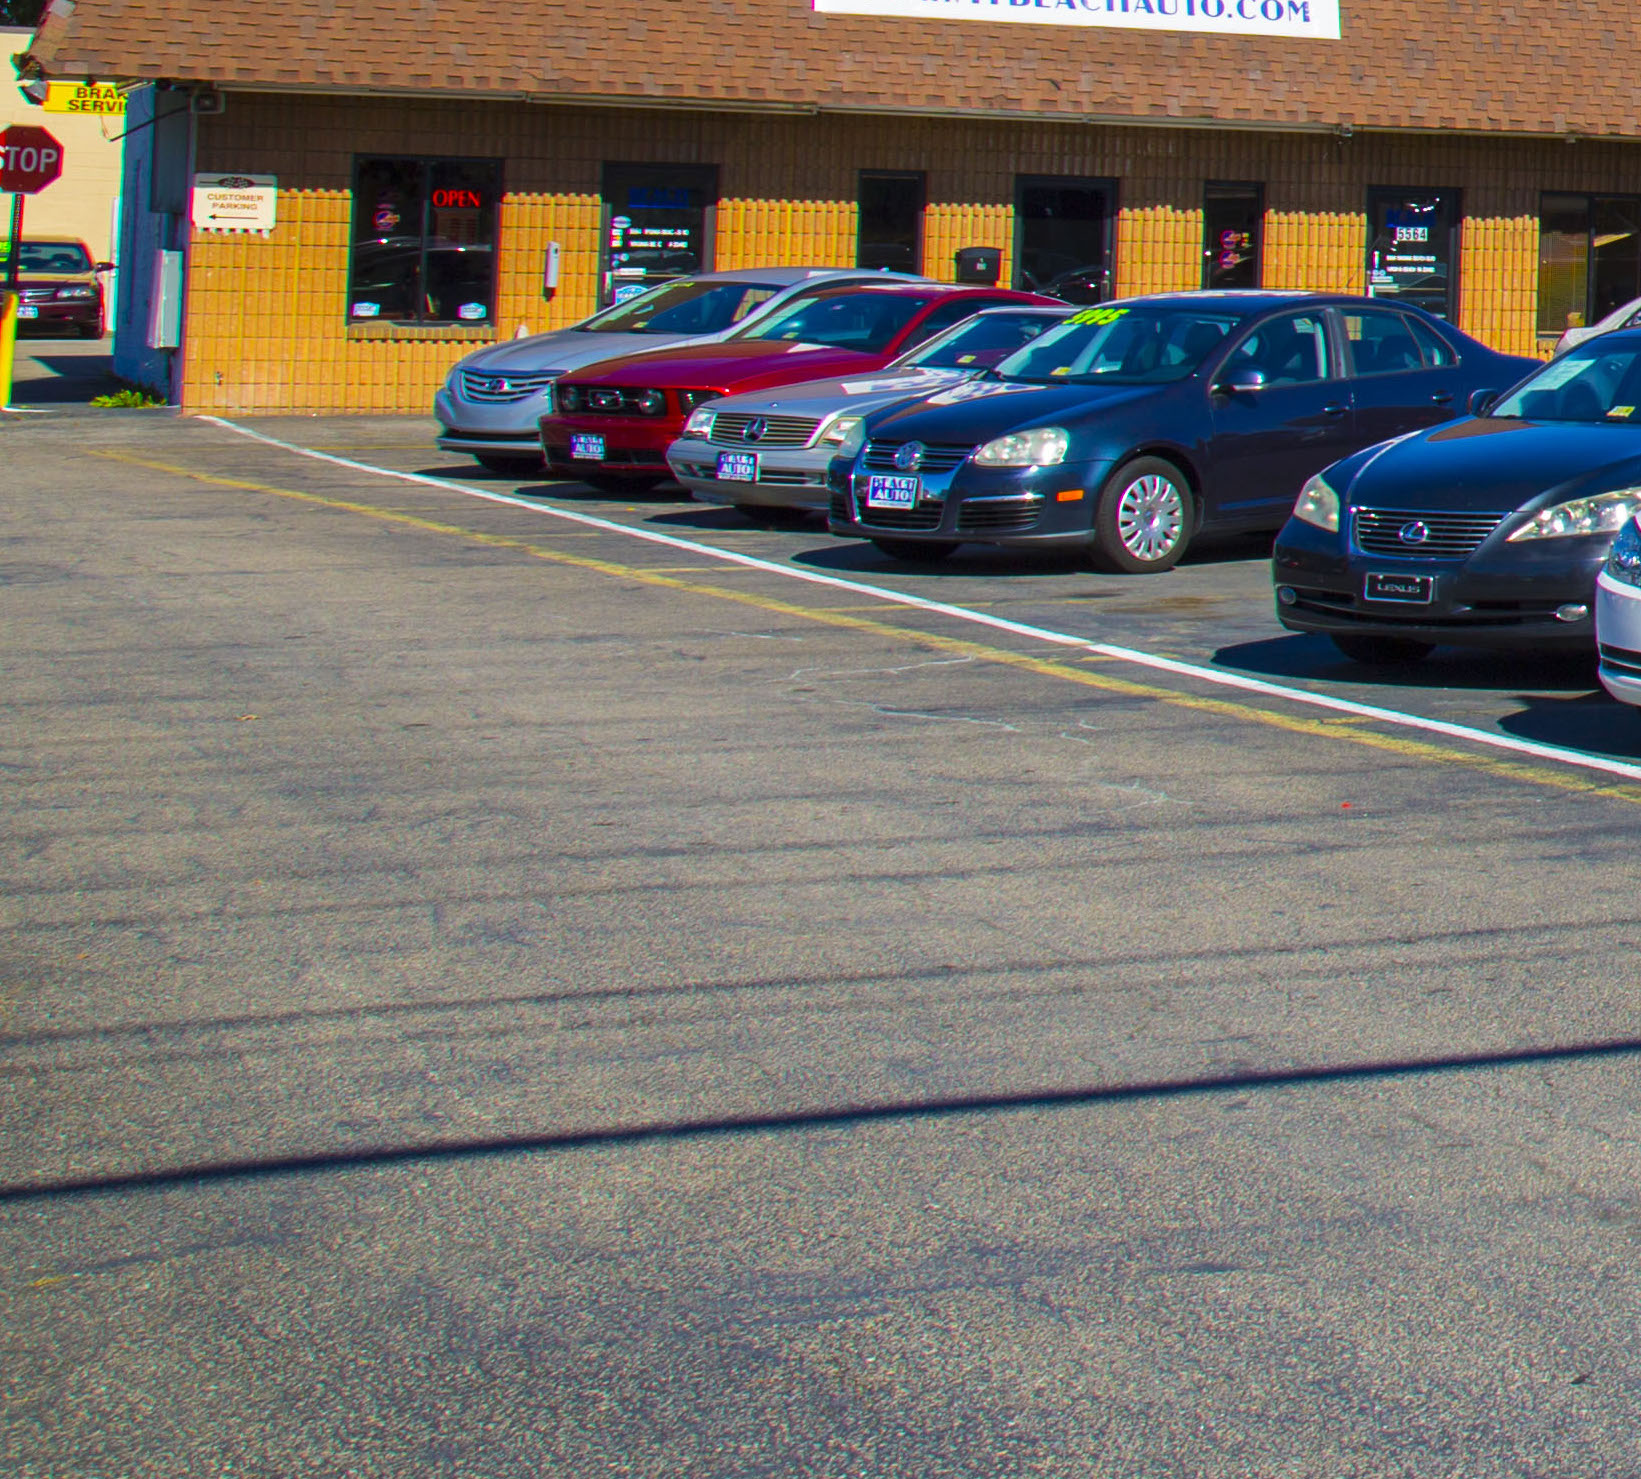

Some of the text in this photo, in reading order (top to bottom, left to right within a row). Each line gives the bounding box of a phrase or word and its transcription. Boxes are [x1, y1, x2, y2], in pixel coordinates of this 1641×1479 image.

[207, 193, 264, 202] CUSTOMER
[432, 189, 481, 208] OPEN
[211, 202, 258, 210] PARKING
[874, 489, 910, 501] AUTO
[1377, 583, 1421, 594] LEXUS
